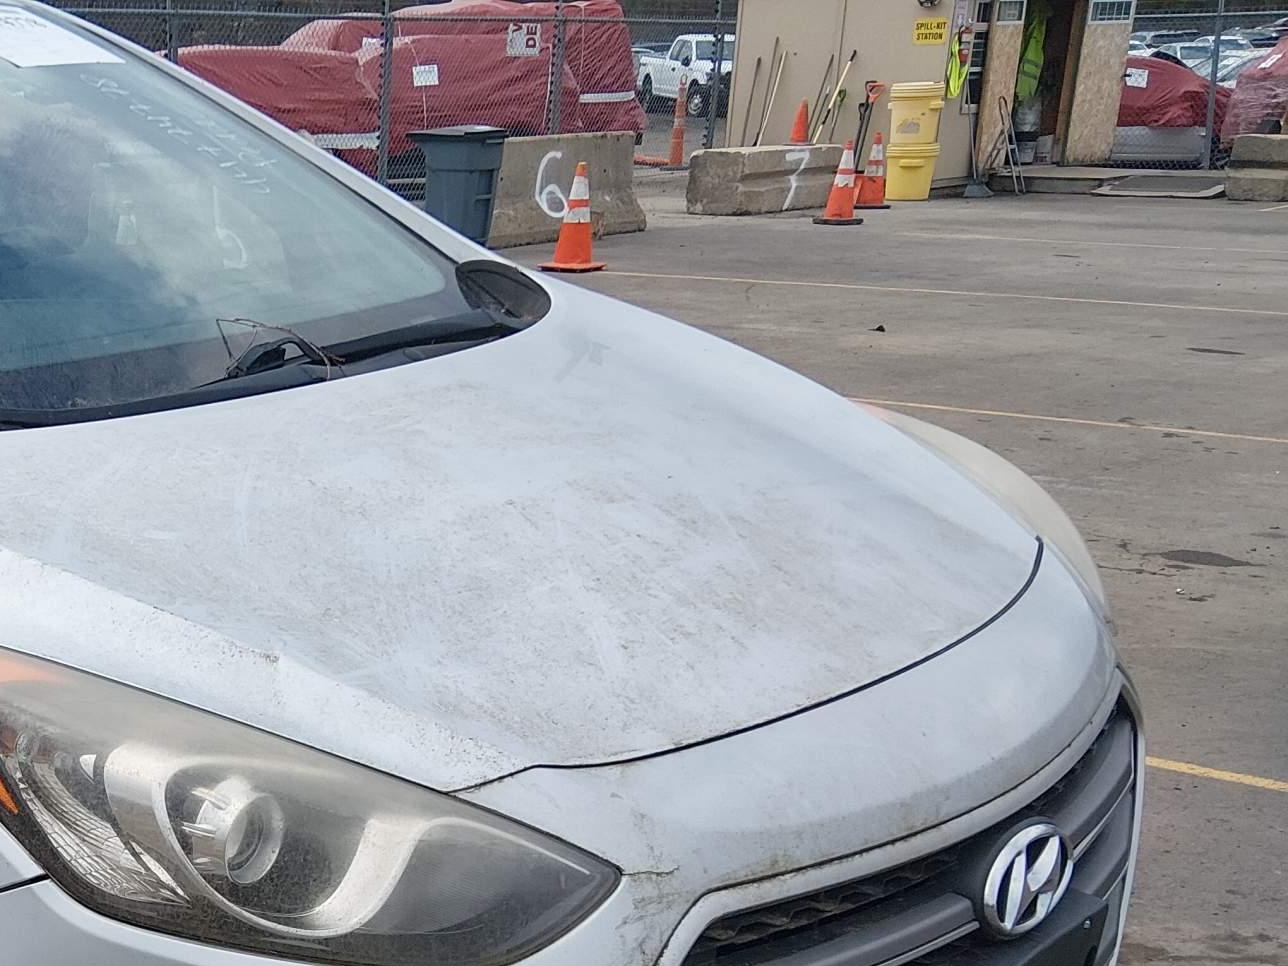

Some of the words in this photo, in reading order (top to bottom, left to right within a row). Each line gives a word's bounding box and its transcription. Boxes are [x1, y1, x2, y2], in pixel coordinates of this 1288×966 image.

[916, 32, 943, 40] STATION
[535, 151, 568, 218] 6
[784, 151, 810, 211] 7
